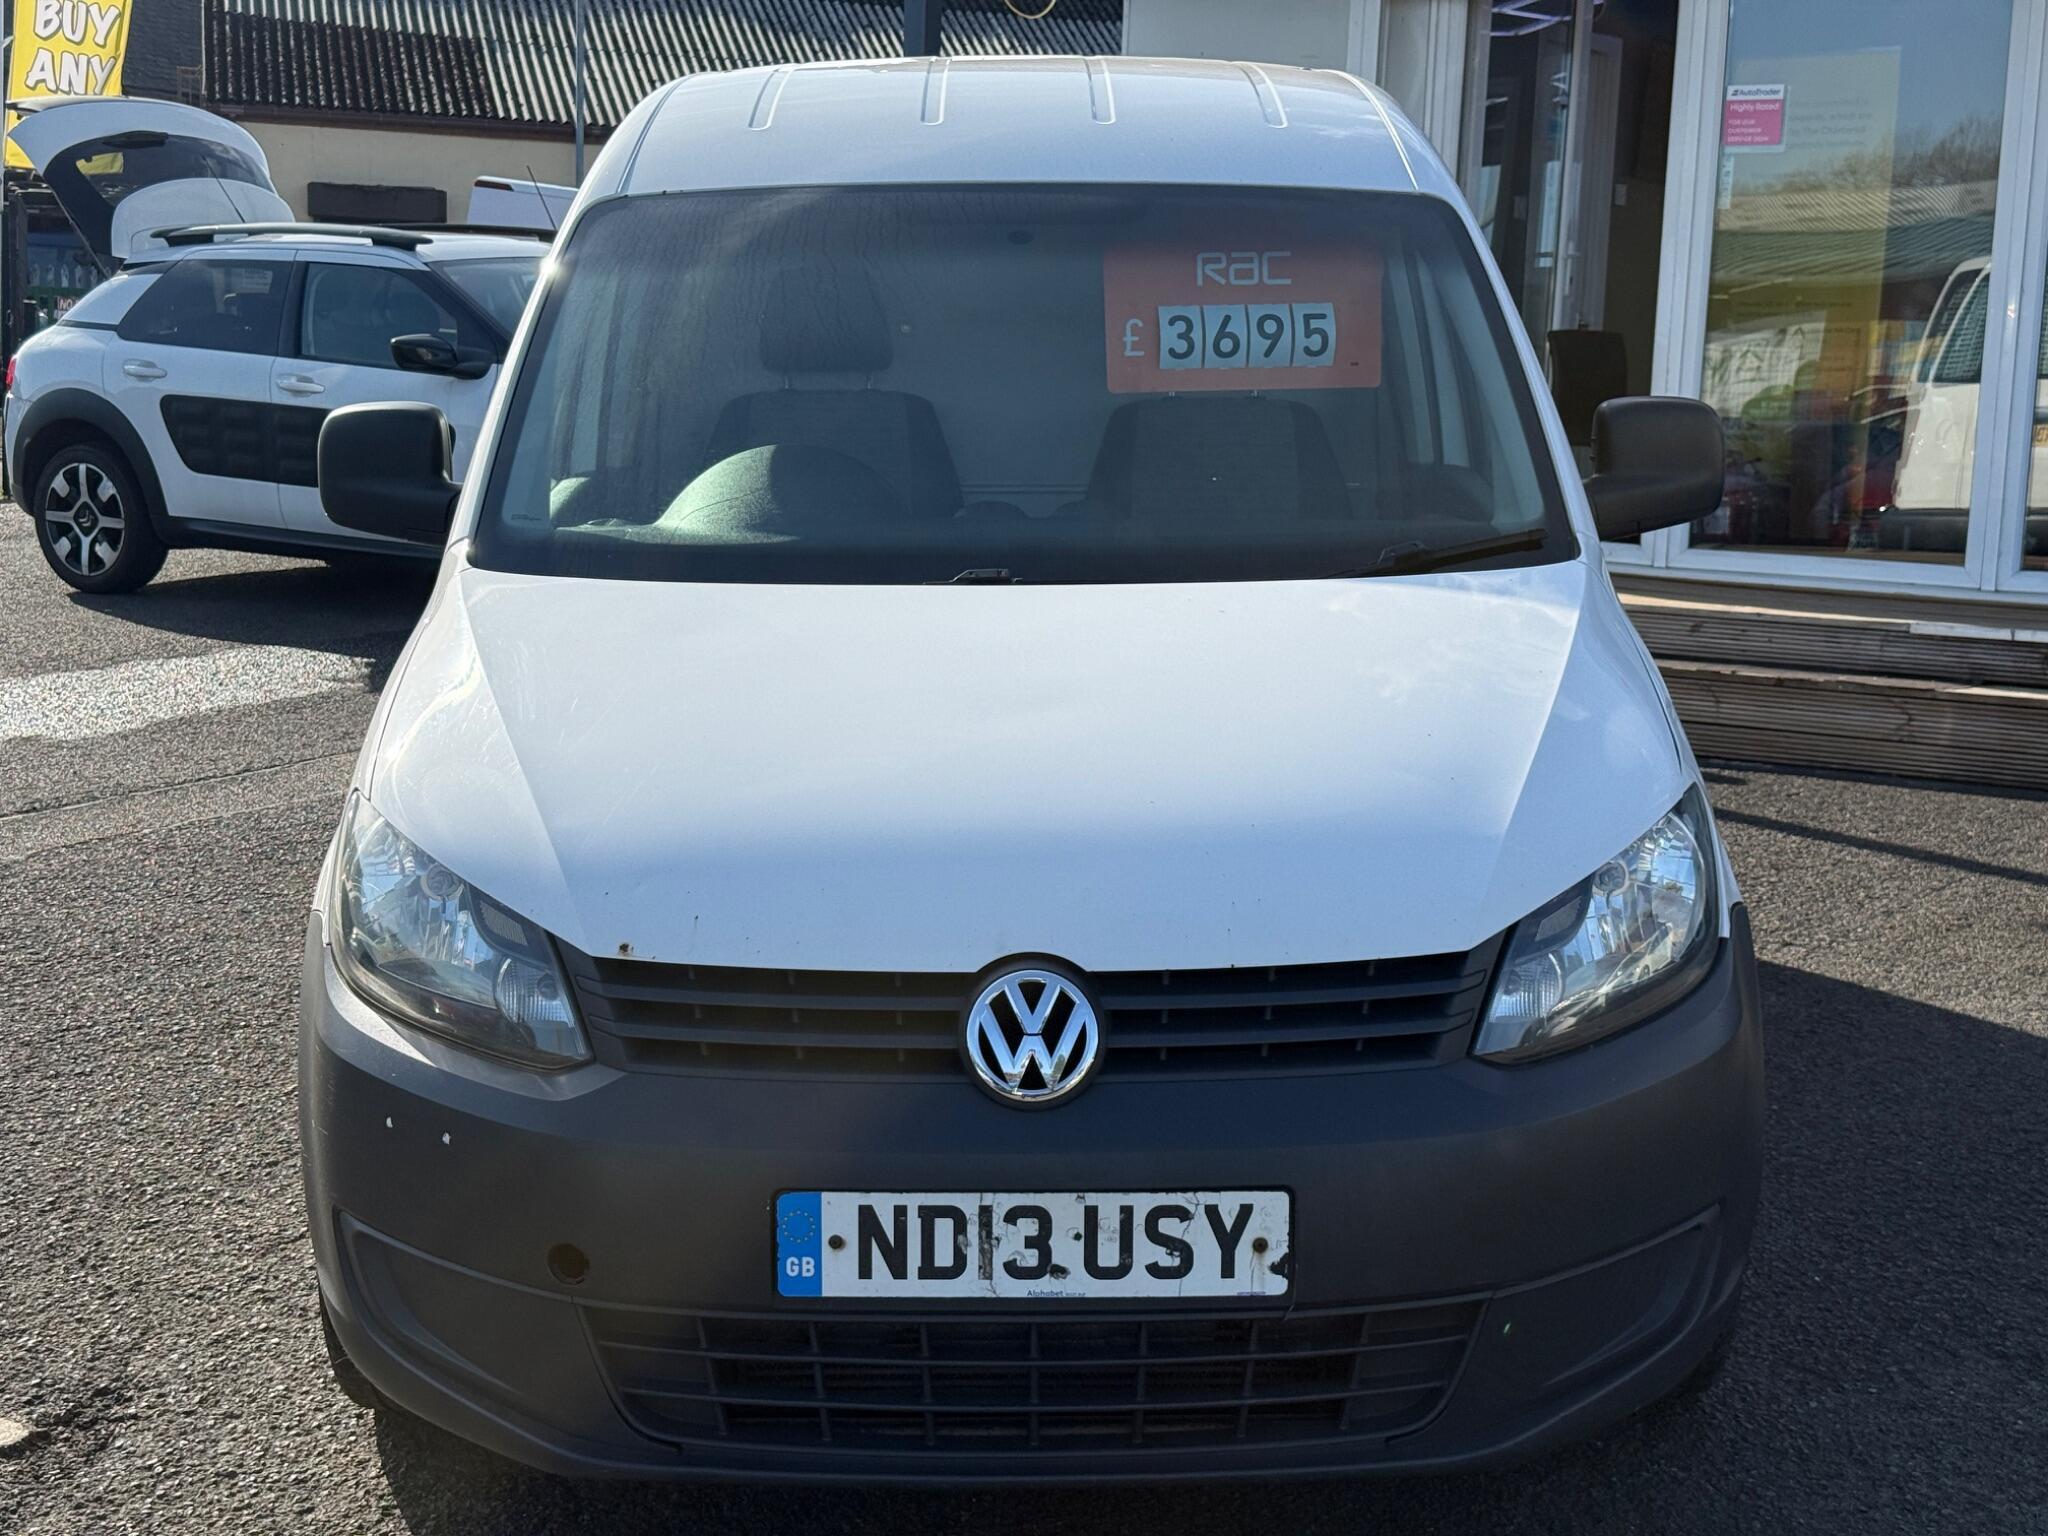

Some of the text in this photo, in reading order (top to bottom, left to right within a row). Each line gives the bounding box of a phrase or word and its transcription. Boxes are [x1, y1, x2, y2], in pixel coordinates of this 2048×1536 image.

[34, 0, 121, 48] BUY
[25, 47, 116, 95] ANY
[1167, 313, 1330, 361] 3695
[857, 1203, 1255, 1280] ND13 USY
[785, 1256, 816, 1279] GB
